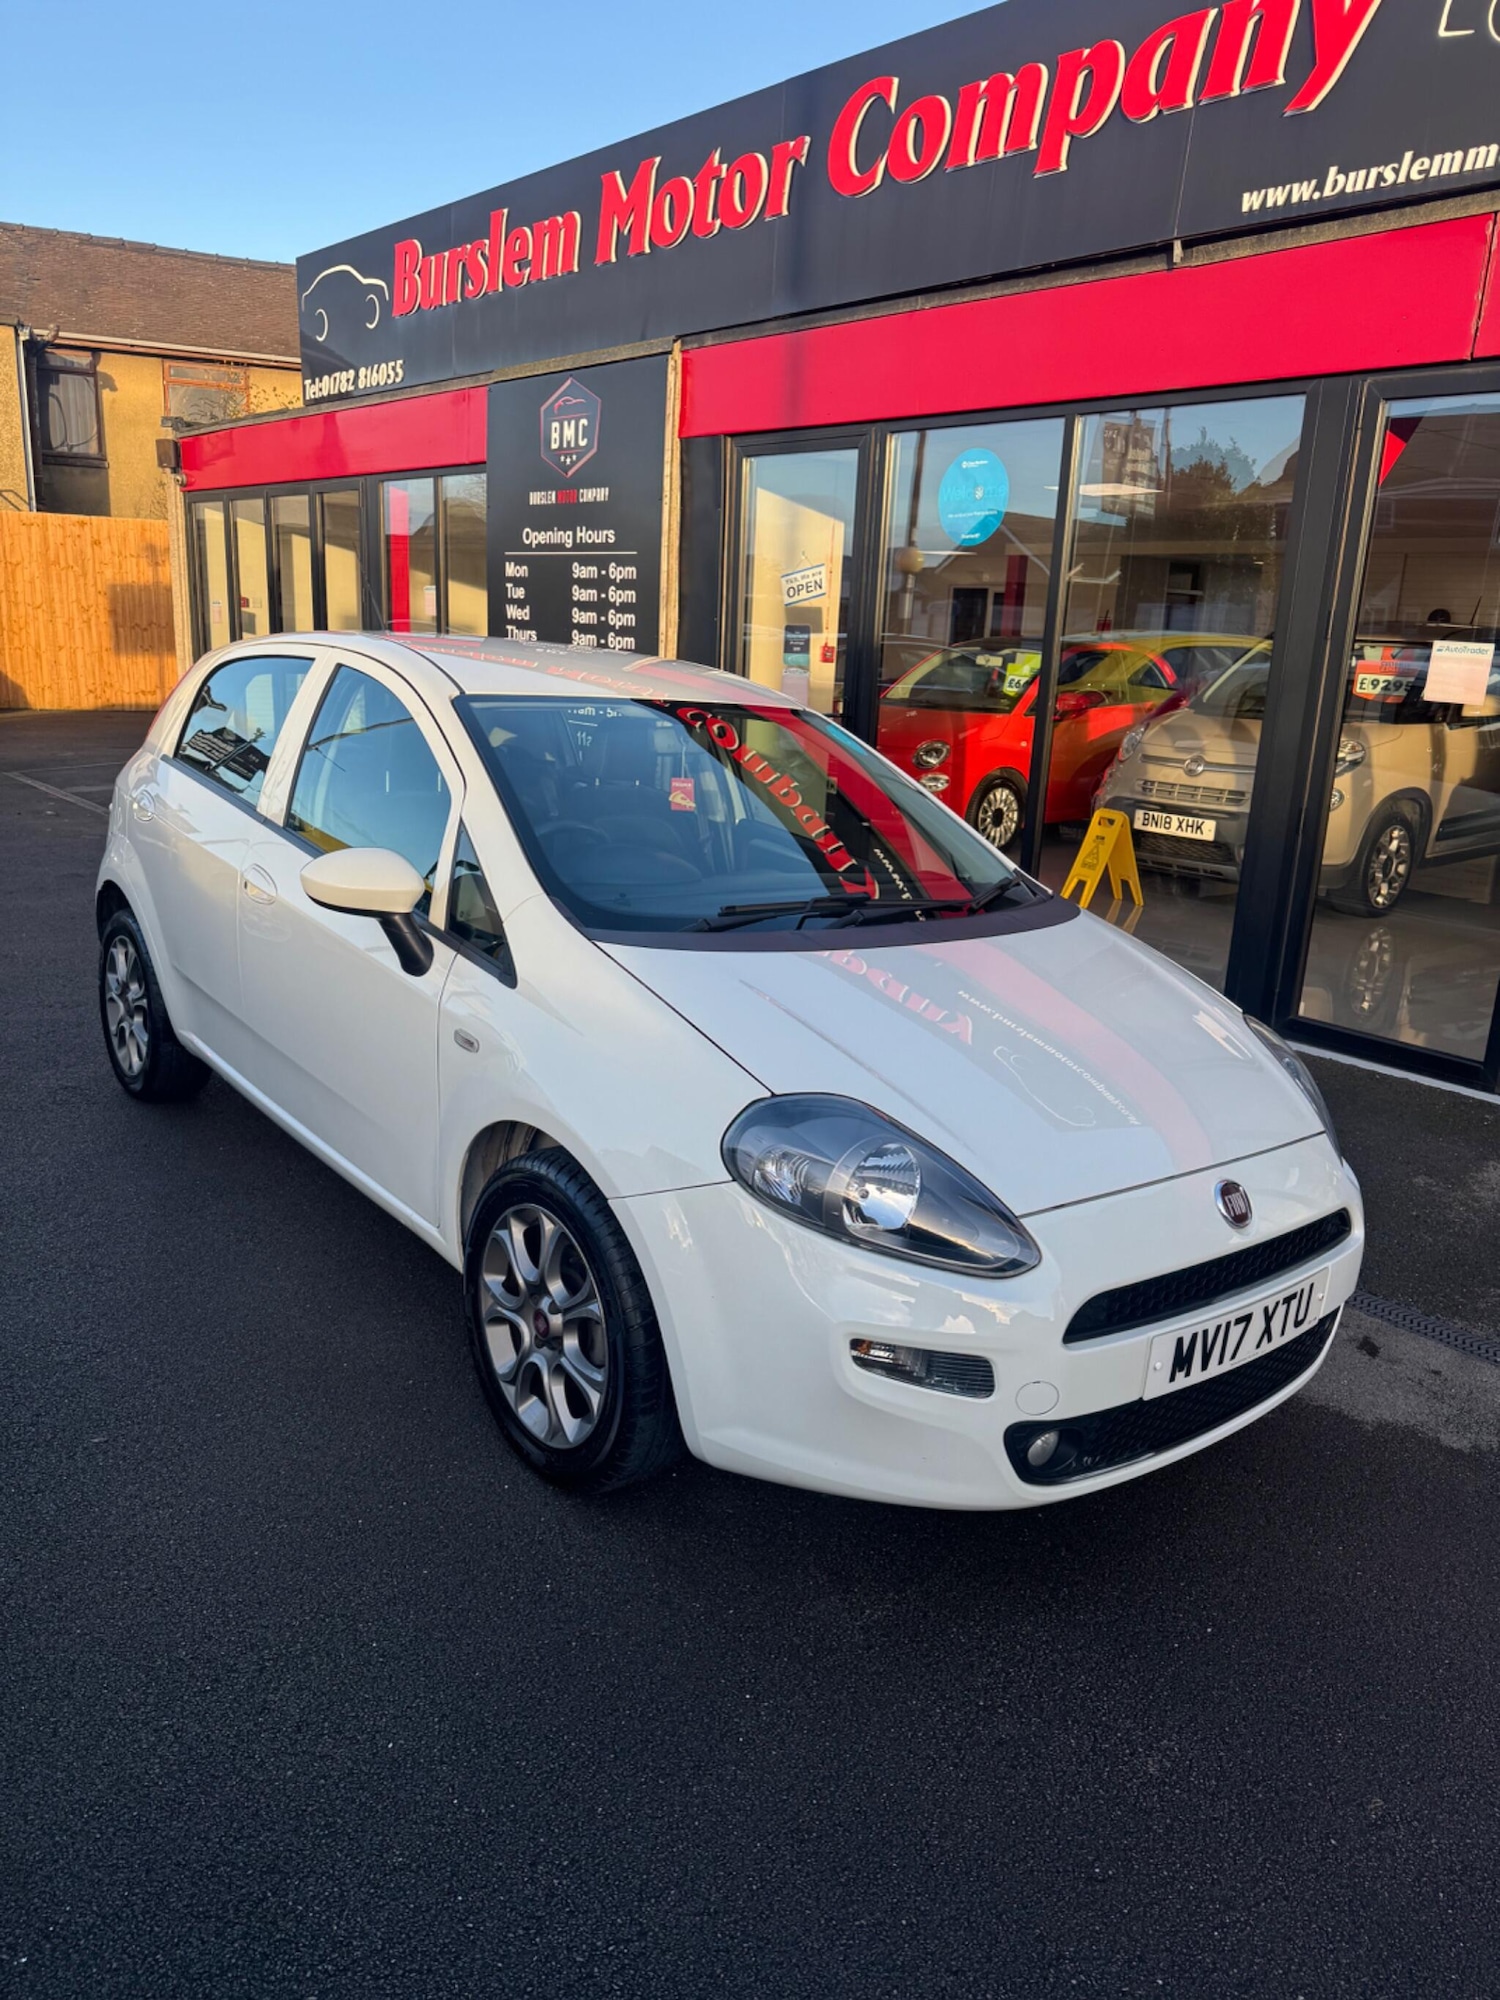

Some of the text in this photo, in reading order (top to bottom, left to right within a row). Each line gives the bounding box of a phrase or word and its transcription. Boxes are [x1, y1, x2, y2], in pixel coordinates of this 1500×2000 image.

[392, 0, 1382, 317] Burslem Motor Company
[1241, 143, 1500, 213] www.burslemm
[304, 360, 404, 400] Tel:01782 816055
[551, 418, 588, 449] BMC
[522, 527, 616, 548] Opening Hours
[505, 562, 528, 577] Mon
[571, 562, 598, 579] 9am
[608, 562, 637, 583] 6pm
[505, 583, 525, 599] Tue
[571, 584, 598, 602] 9am
[608, 585, 636, 606] 6pm
[787, 579, 822, 598] OPEN
[506, 604, 530, 620] Wed
[571, 607, 598, 625] 9am
[608, 609, 636, 630] 6pm
[505, 625, 537, 641] Thurs
[571, 629, 598, 647] 9am
[607, 632, 635, 651] 6pm
[1444, 646, 1489, 655] AutoTrader
[1142, 812, 1205, 836] BN18 XHK
[1169, 1281, 1315, 1384] MV17 XTU
